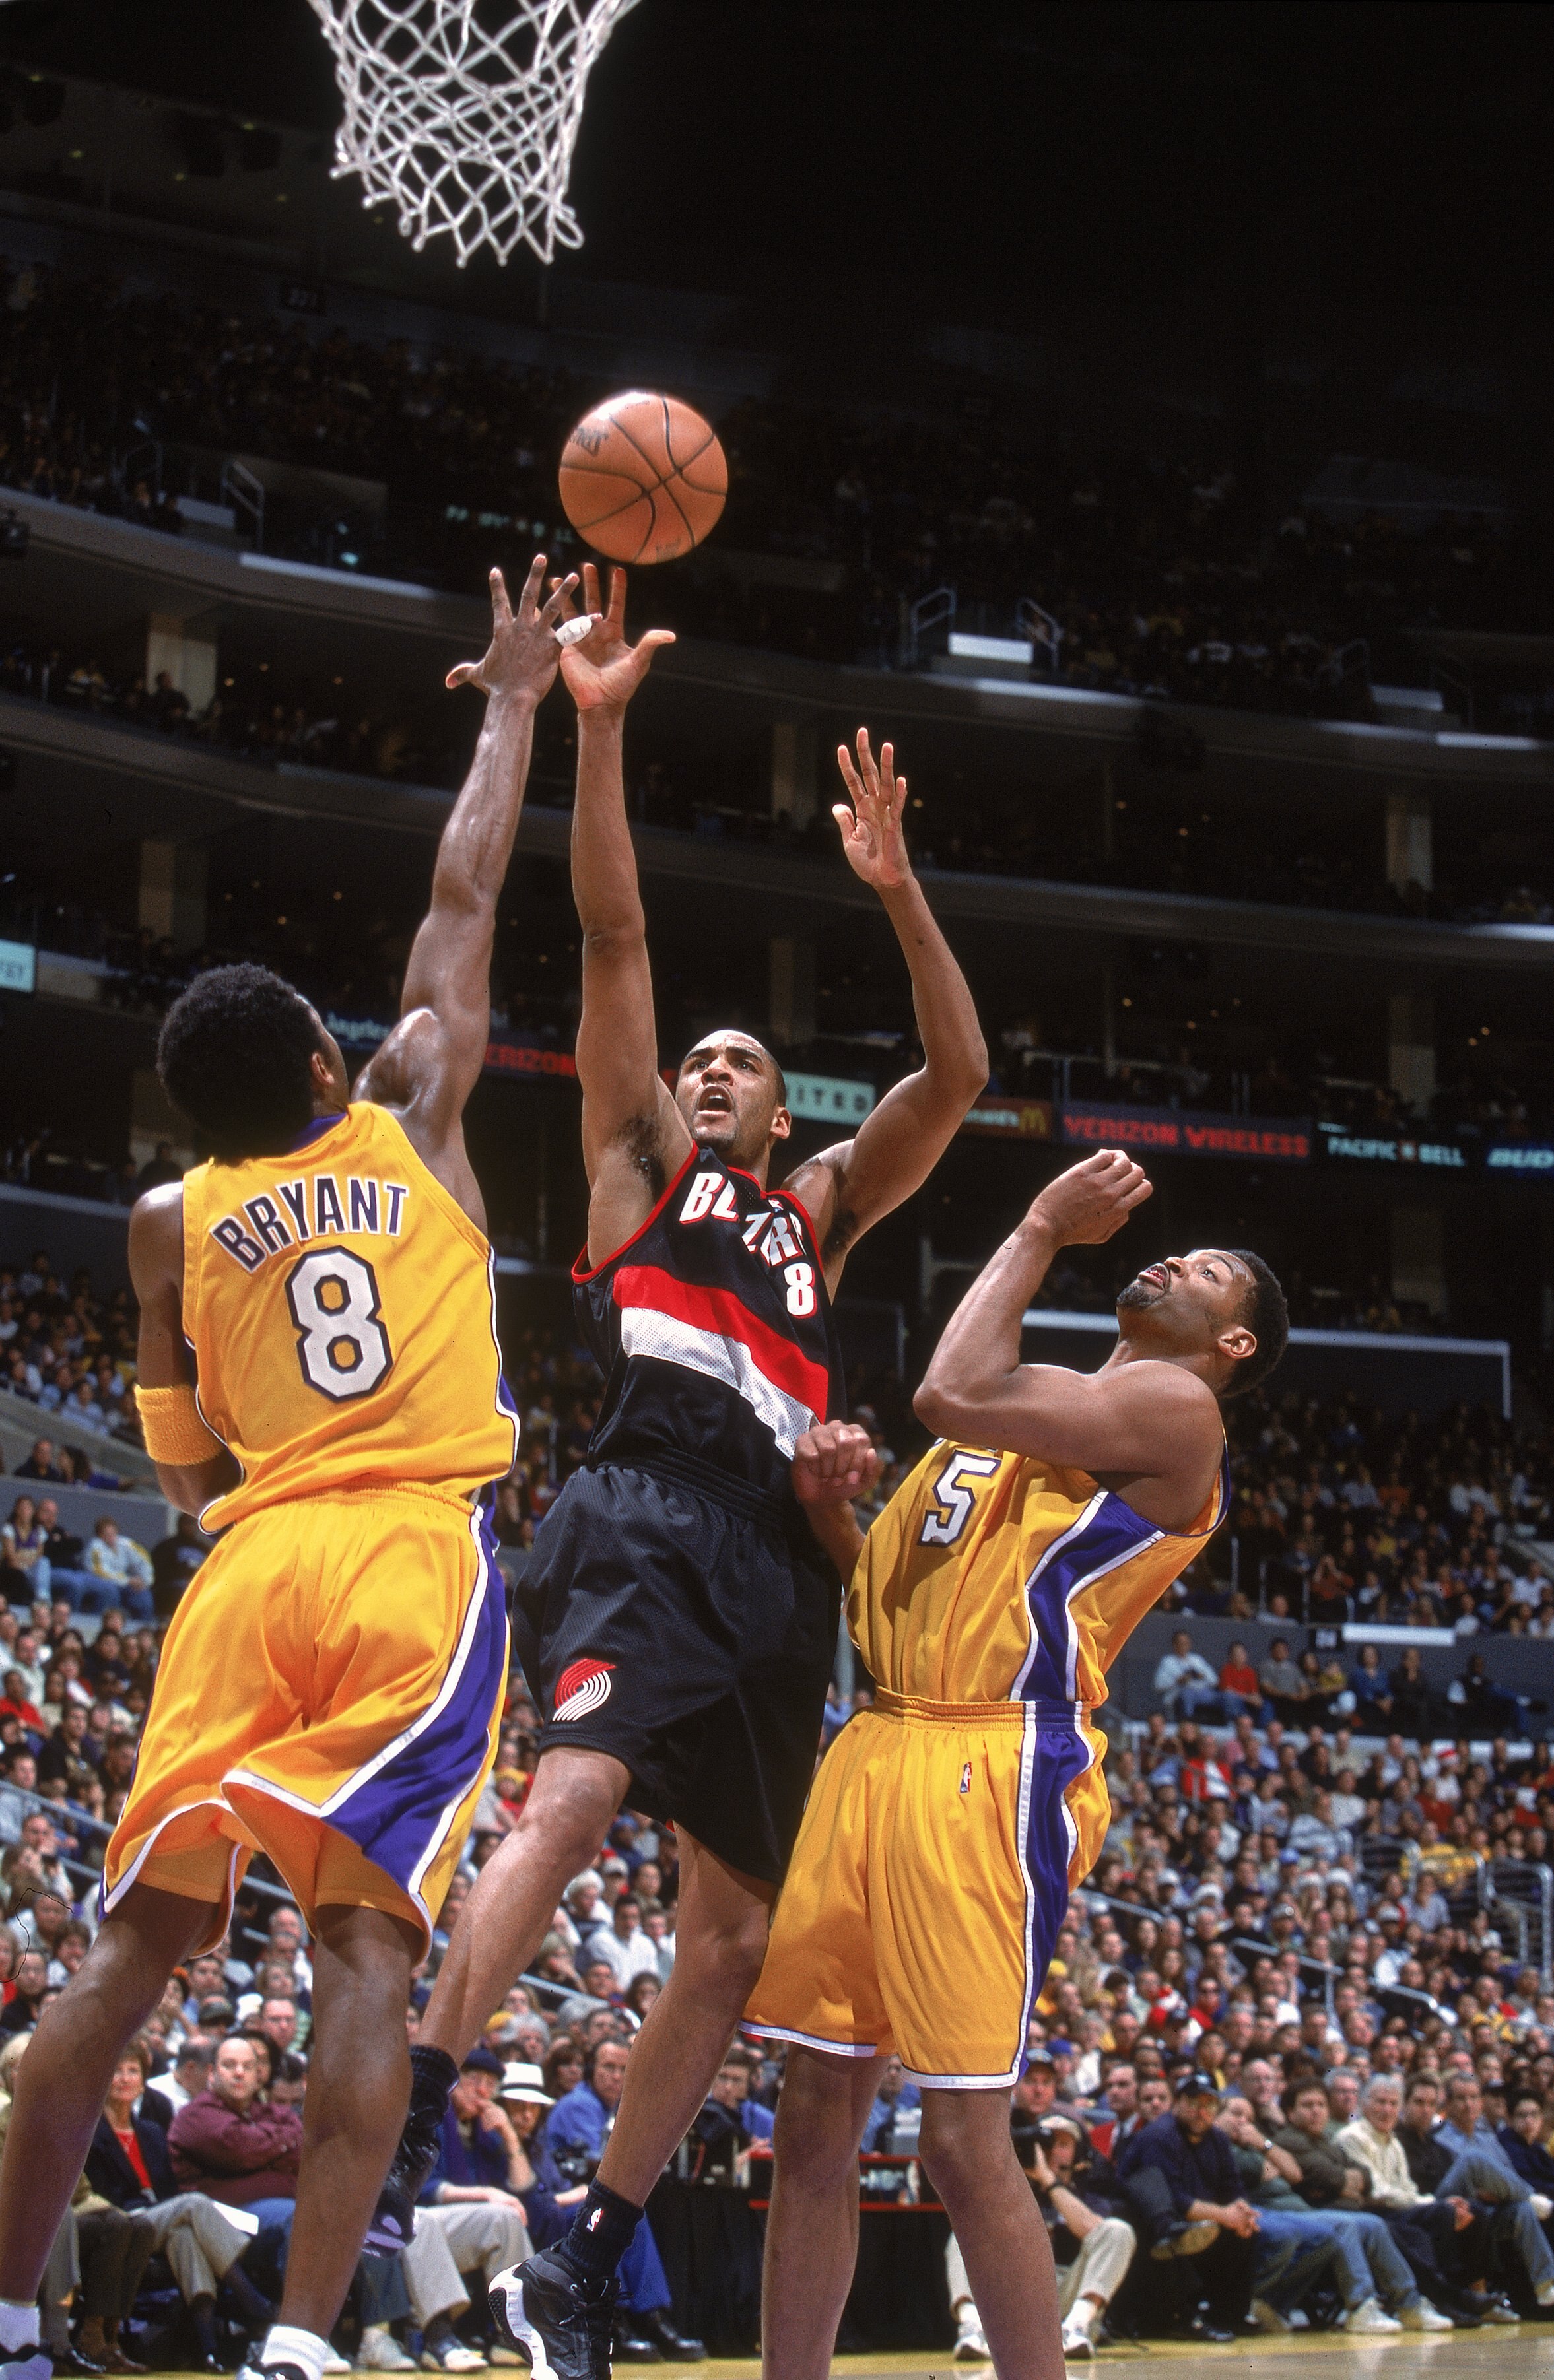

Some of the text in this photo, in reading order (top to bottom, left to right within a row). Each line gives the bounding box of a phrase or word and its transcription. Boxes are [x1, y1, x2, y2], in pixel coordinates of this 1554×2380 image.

[485, 1043, 576, 1076] ERIZON
[786, 1086, 868, 1112] ITED
[1062, 1115, 1310, 1159] VERIZON WIRELESS
[1327, 1135, 1467, 1168] PACIFIC BELL
[209, 1173, 409, 1274] BRYANT
[783, 1261, 818, 1319] 8
[284, 1245, 394, 1405] 8
[917, 1449, 1003, 1548] 5
